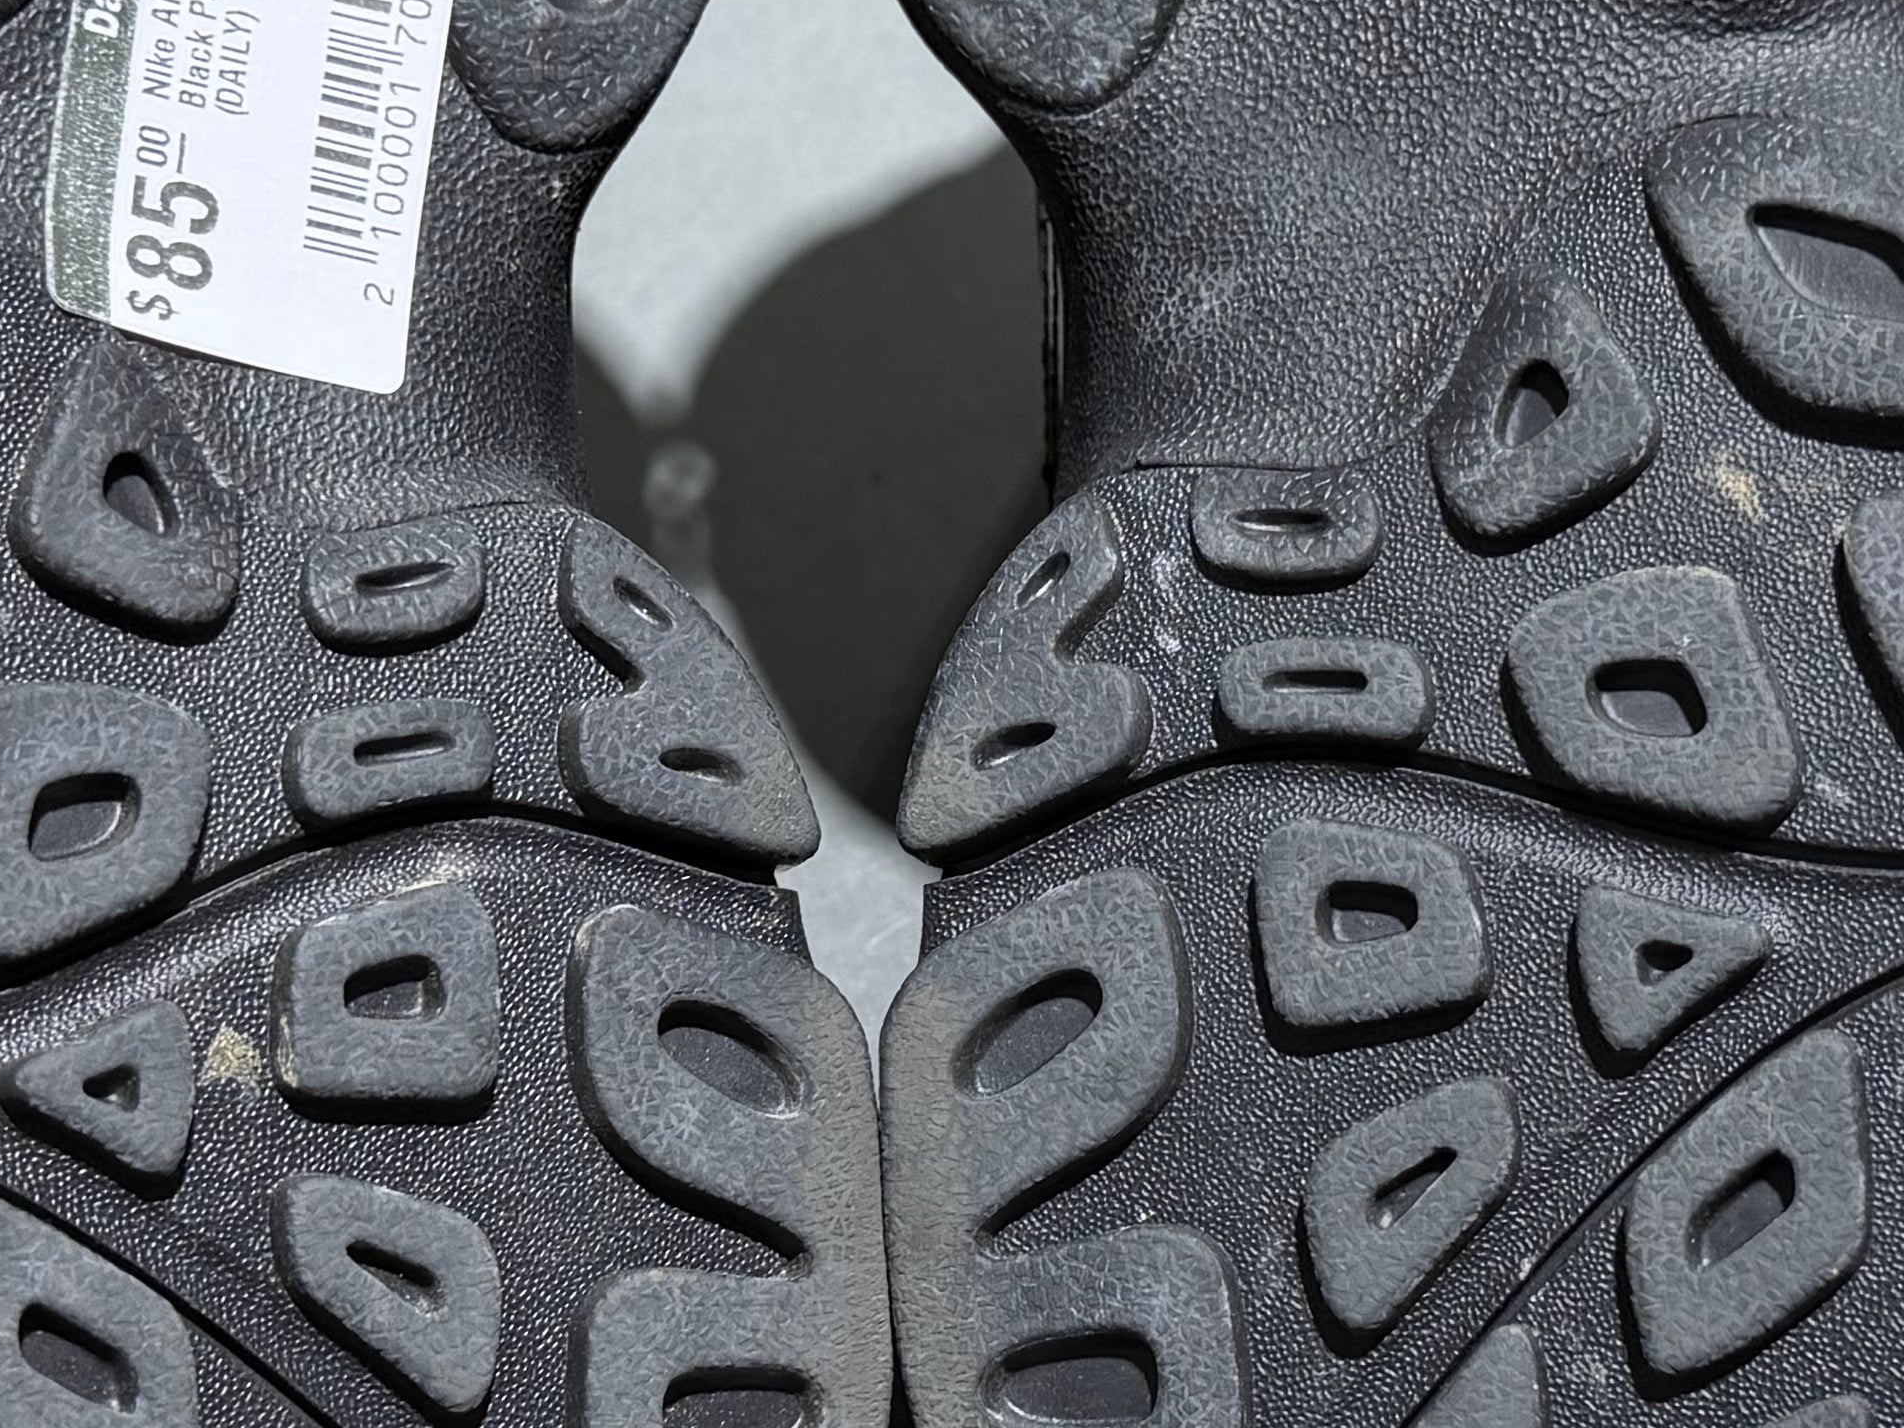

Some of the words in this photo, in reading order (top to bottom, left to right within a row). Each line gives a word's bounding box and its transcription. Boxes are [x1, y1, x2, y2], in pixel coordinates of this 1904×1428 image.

[141, 38, 176, 100] Nike
[178, 30, 214, 108] Black
[214, 10, 261, 115] (DAILY)
[136, 125, 170, 167] 00
[371, 81, 421, 238] 100001
[125, 175, 219, 321] $85
[363, 282, 395, 307] 2
